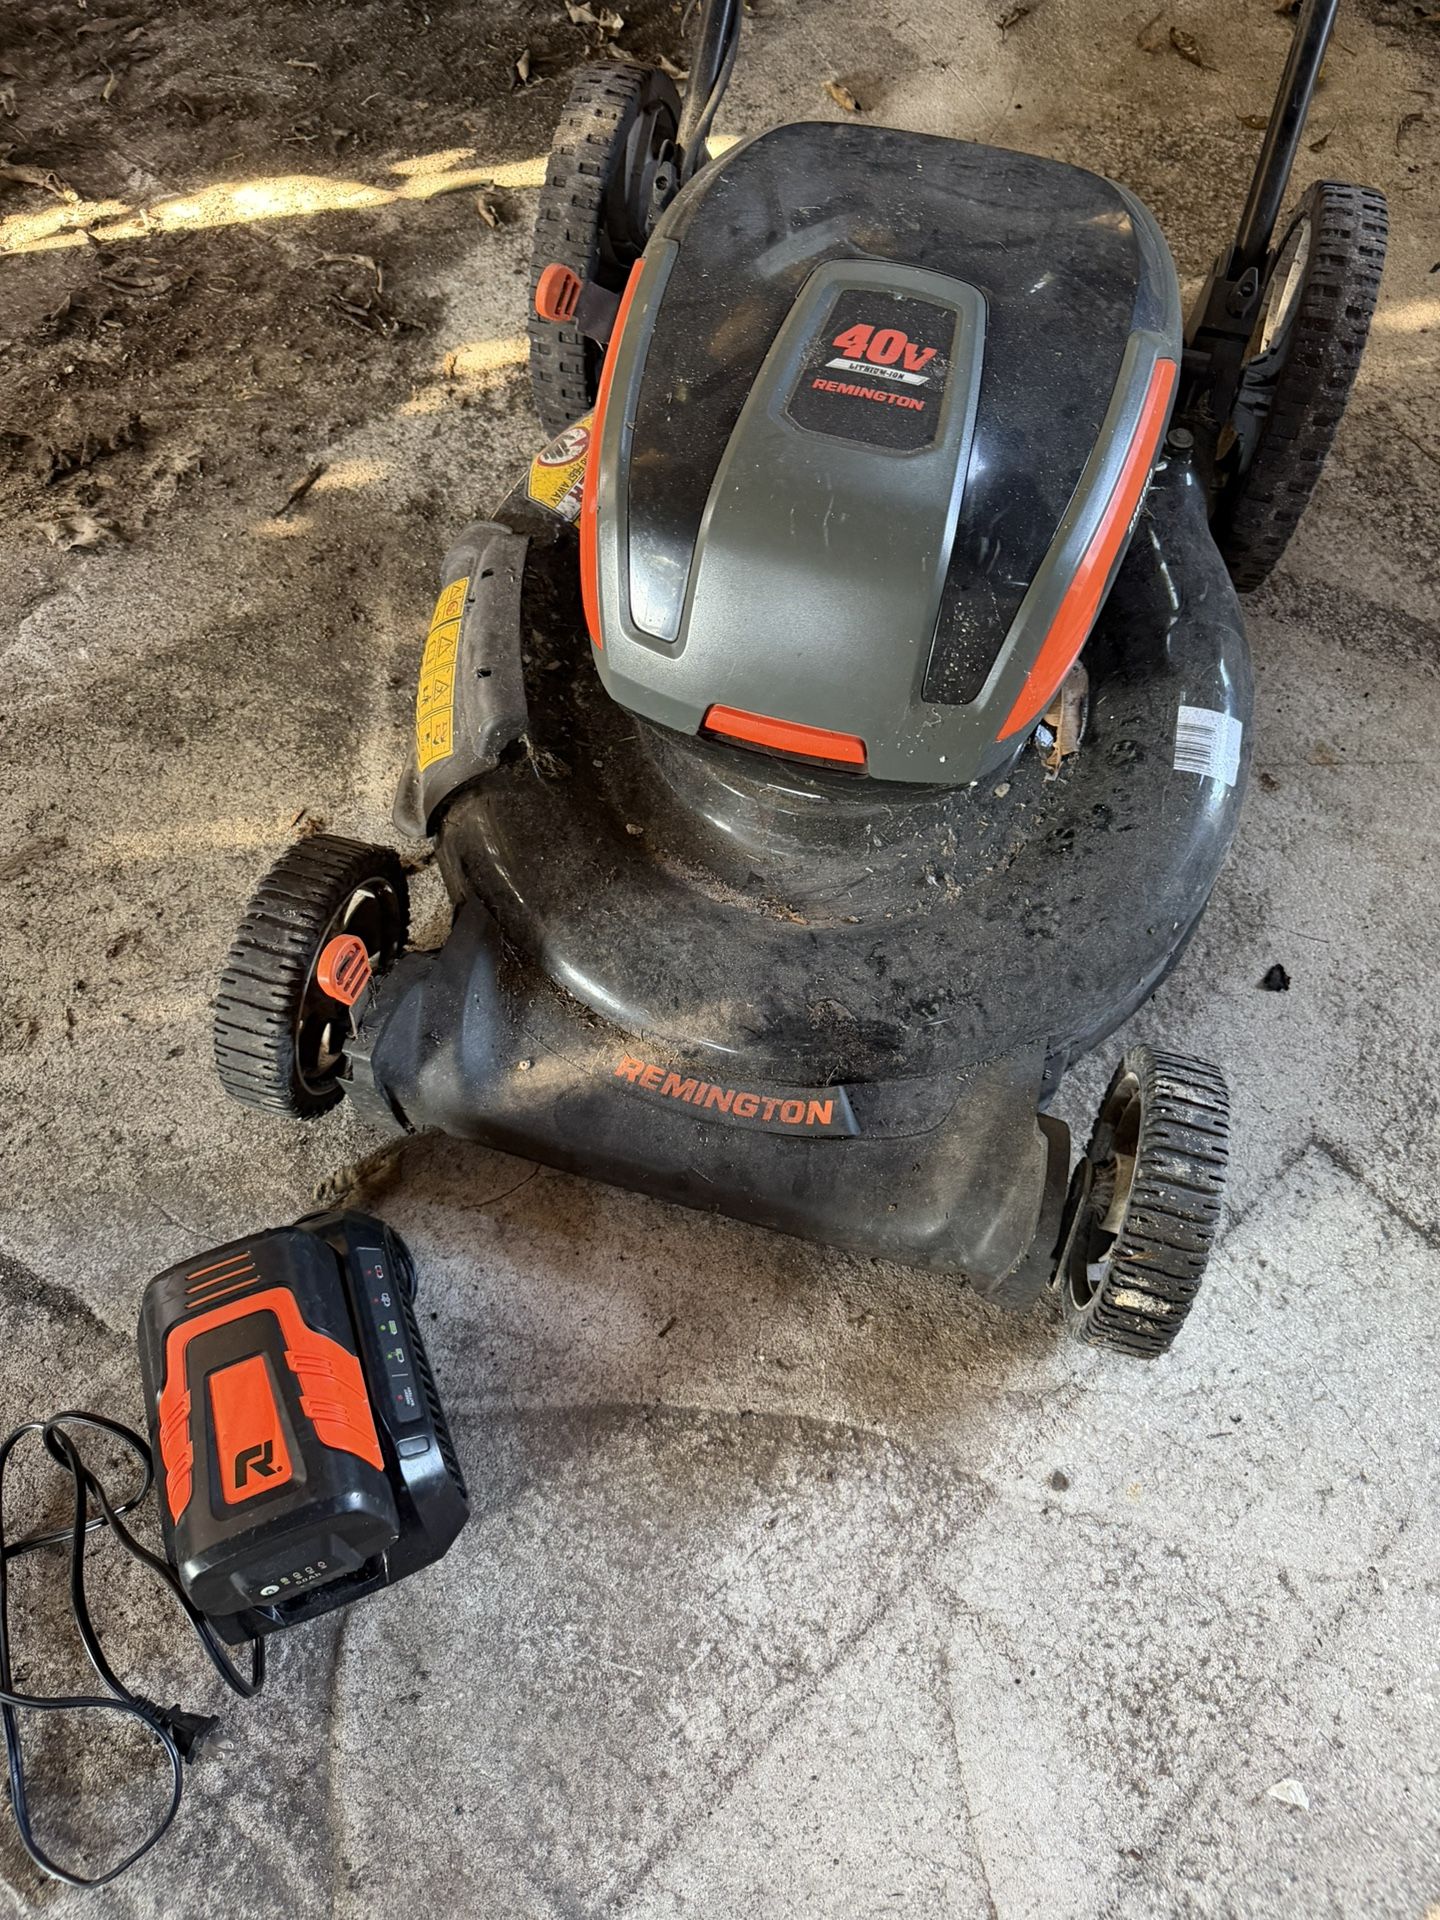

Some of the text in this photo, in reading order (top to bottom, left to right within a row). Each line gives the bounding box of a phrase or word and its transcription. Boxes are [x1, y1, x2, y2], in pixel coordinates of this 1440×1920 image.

[832, 323, 937, 372] 40V
[848, 363, 906, 380] LITHIUM-ION
[812, 378, 926, 412] REMINGTON
[550, 481, 570, 504] AWAY
[614, 1055, 834, 1126] REMINGTON
